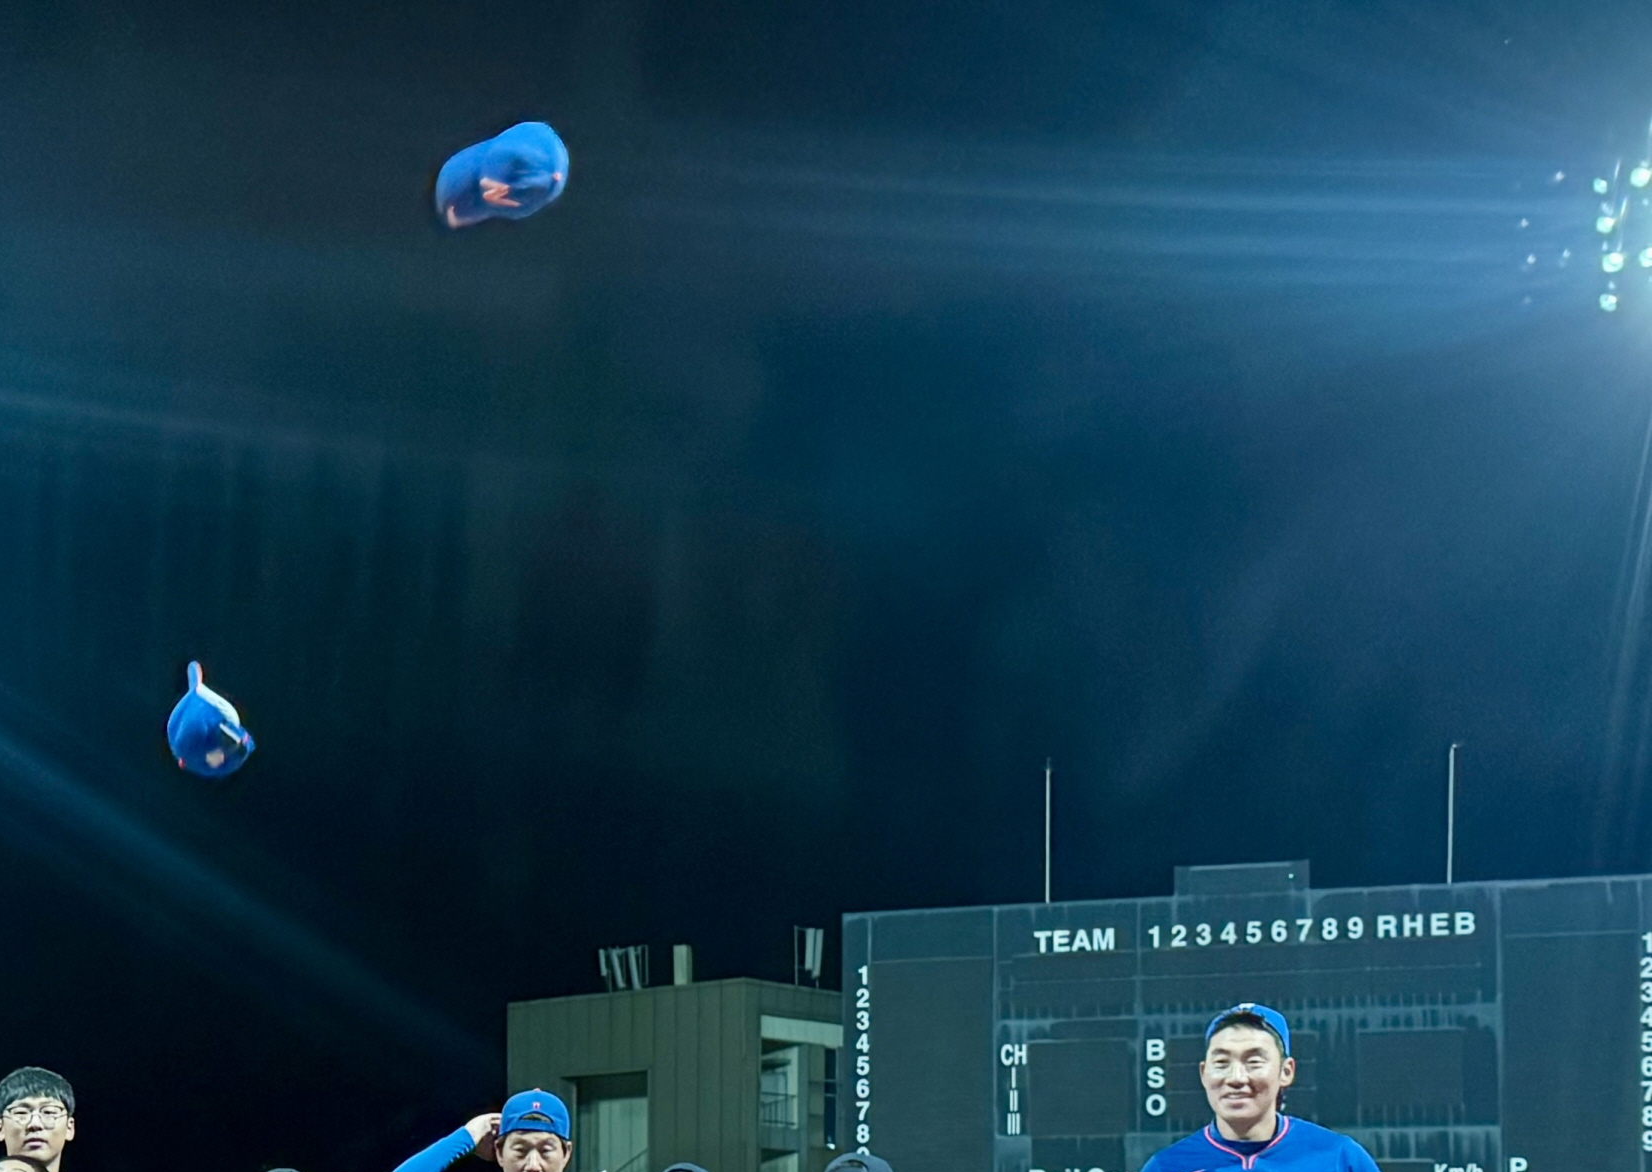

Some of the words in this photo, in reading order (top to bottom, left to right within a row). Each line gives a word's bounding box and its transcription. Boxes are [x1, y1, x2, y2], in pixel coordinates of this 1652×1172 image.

[1033, 928, 1115, 953] TEAM
[858, 966, 868, 985] 1
[856, 988, 870, 1008] 2
[856, 1011, 870, 1030] 3
[856, 1034, 870, 1053] 4
[1146, 1039, 1166, 1061] B
[1000, 1044, 1027, 1066] CH
[856, 1056, 870, 1075] 5
[1147, 1066, 1165, 1088] S
[856, 1079, 870, 1098] 6
[856, 1101, 870, 1121] 7
[1145, 1094, 1166, 1116] O
[856, 1124, 870, 1143] 8
